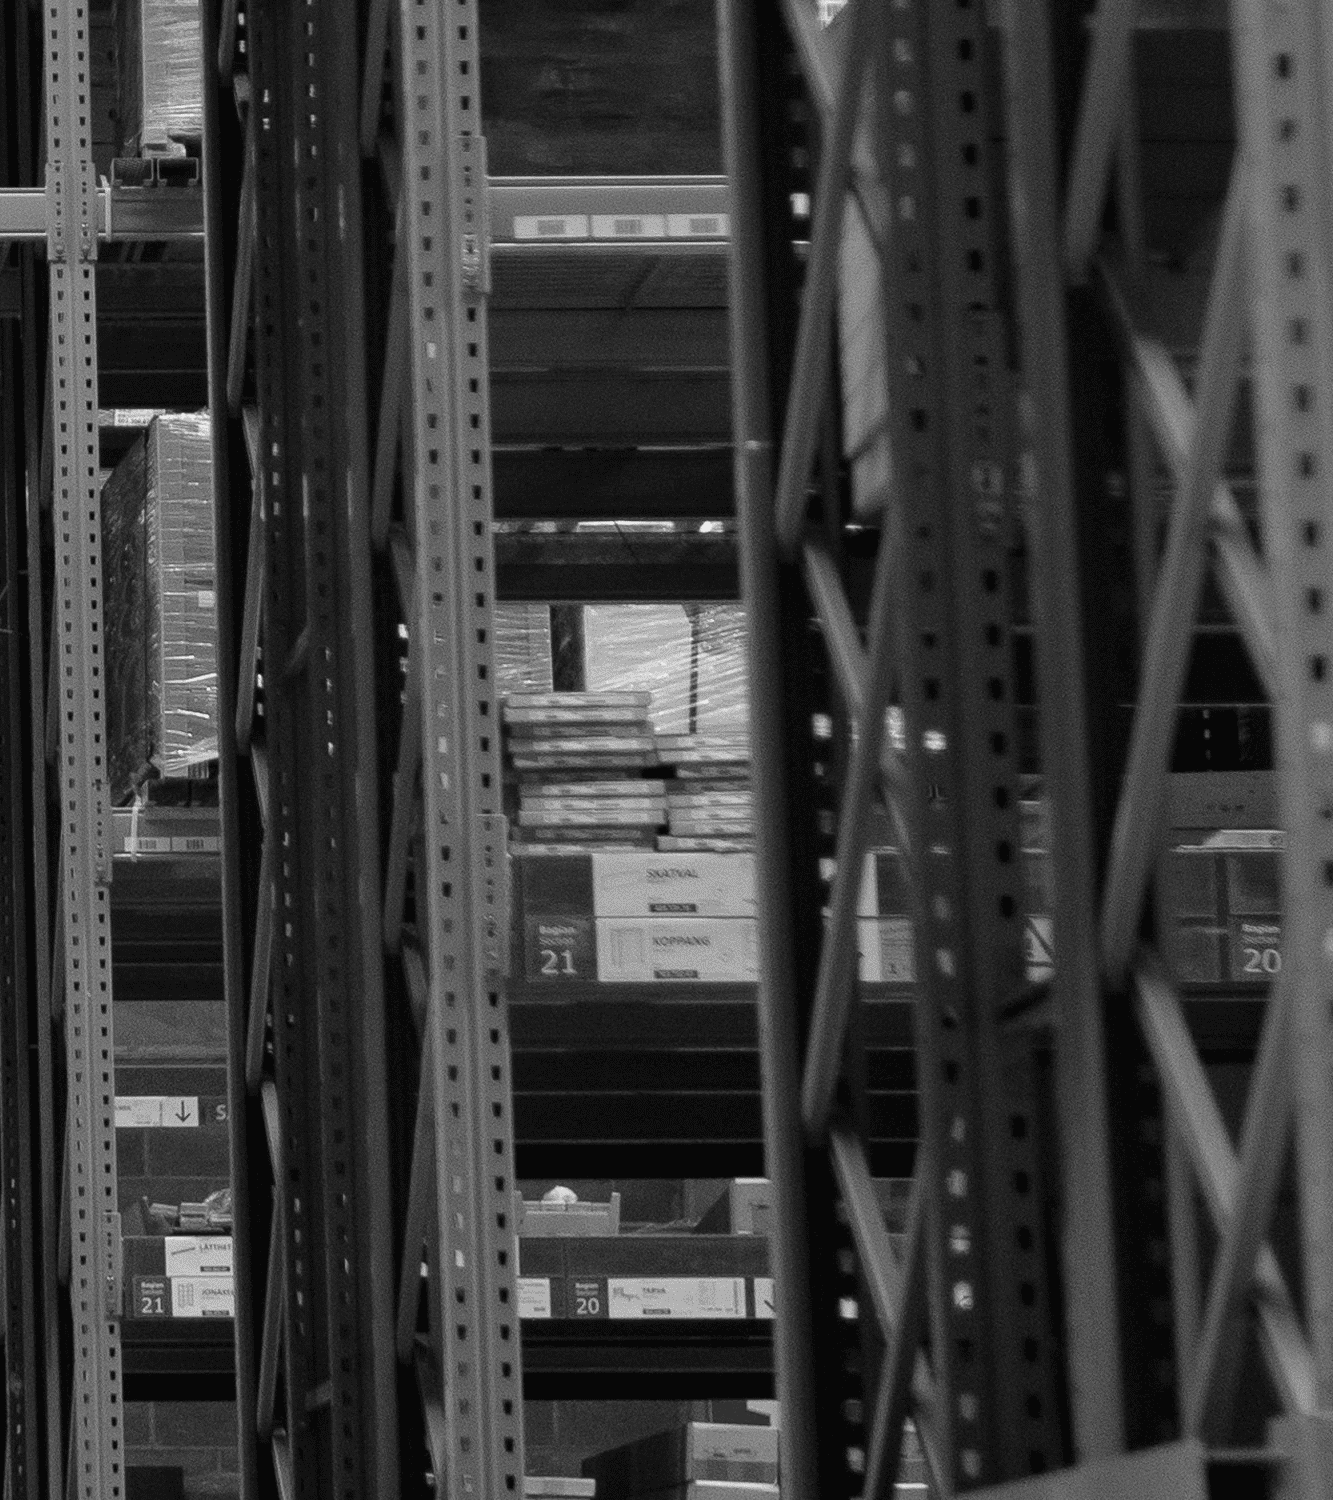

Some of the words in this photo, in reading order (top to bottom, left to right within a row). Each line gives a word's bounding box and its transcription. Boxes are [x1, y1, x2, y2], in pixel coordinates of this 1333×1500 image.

[540, 949, 577, 974] 21
[1243, 948, 1282, 973] 20
[141, 1297, 163, 1314] 21
[576, 1297, 600, 1315] 20
